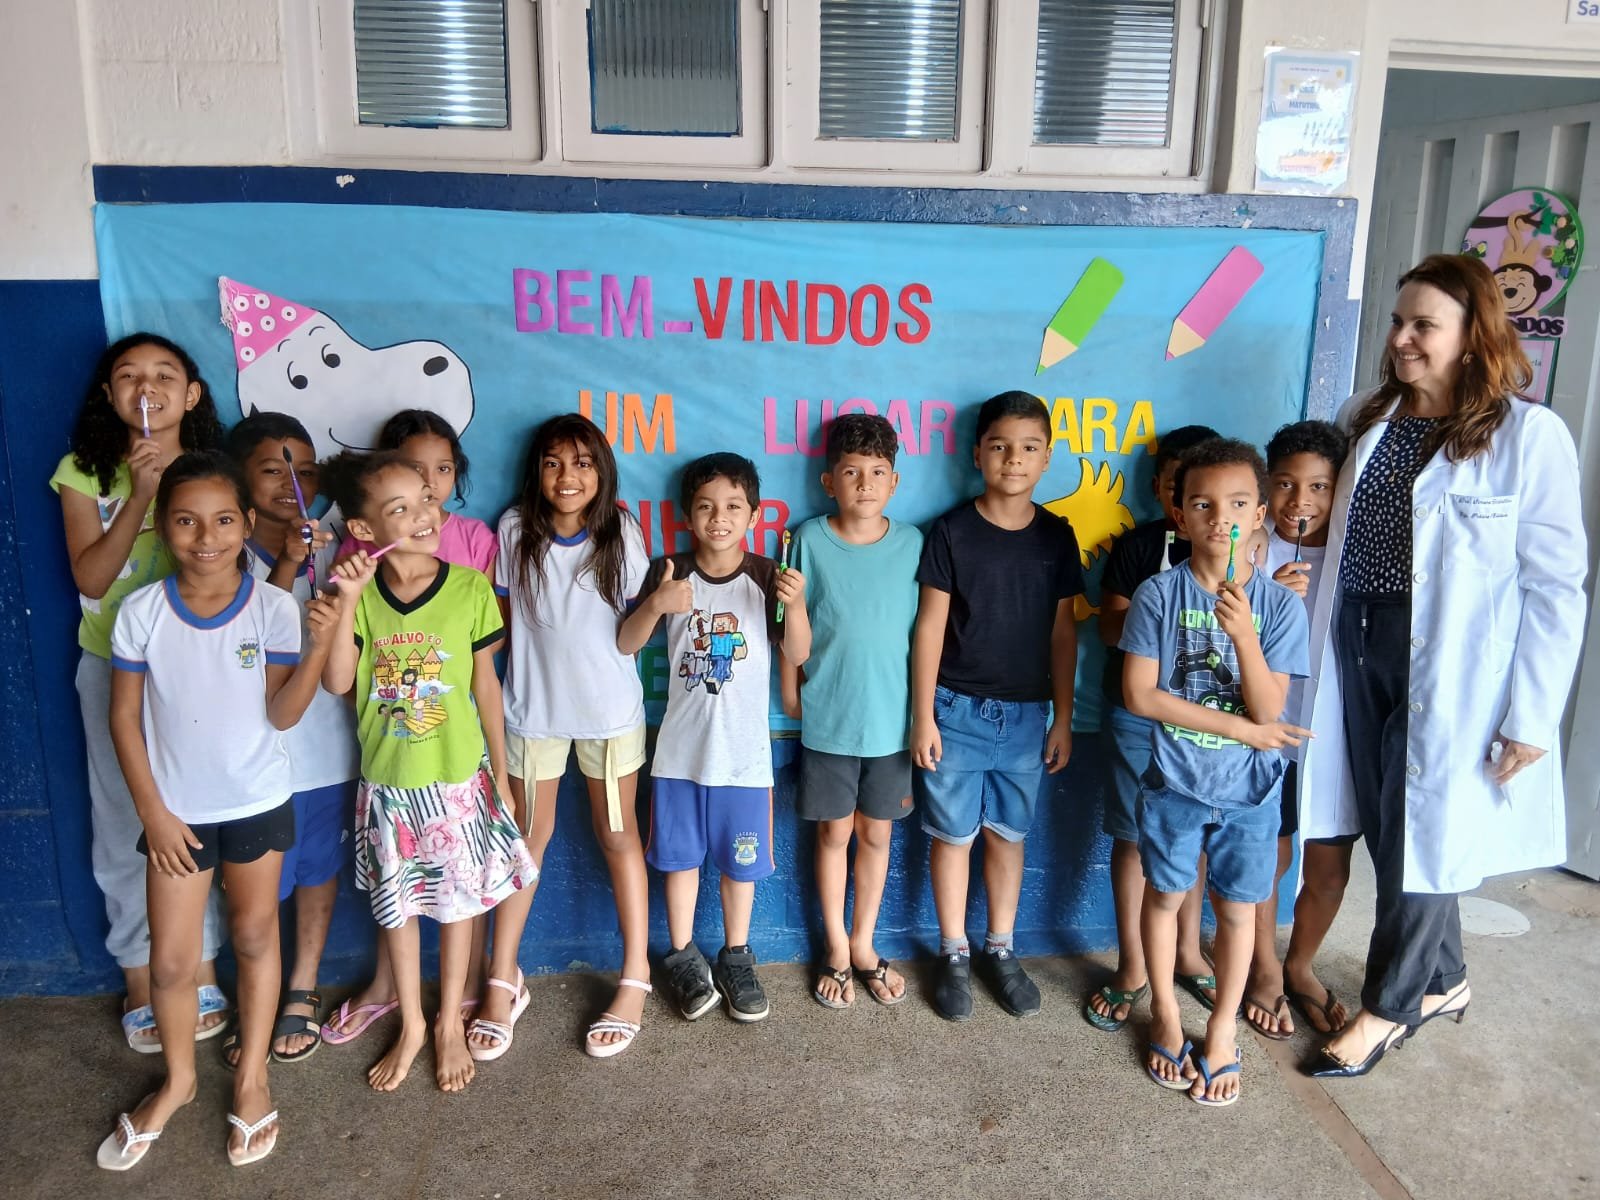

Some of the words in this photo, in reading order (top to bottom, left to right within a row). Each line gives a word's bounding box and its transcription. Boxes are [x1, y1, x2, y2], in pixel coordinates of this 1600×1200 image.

[764, 397, 957, 455] LUAR
[1038, 397, 1158, 455] ARA
[392, 632, 424, 645] ALVO
